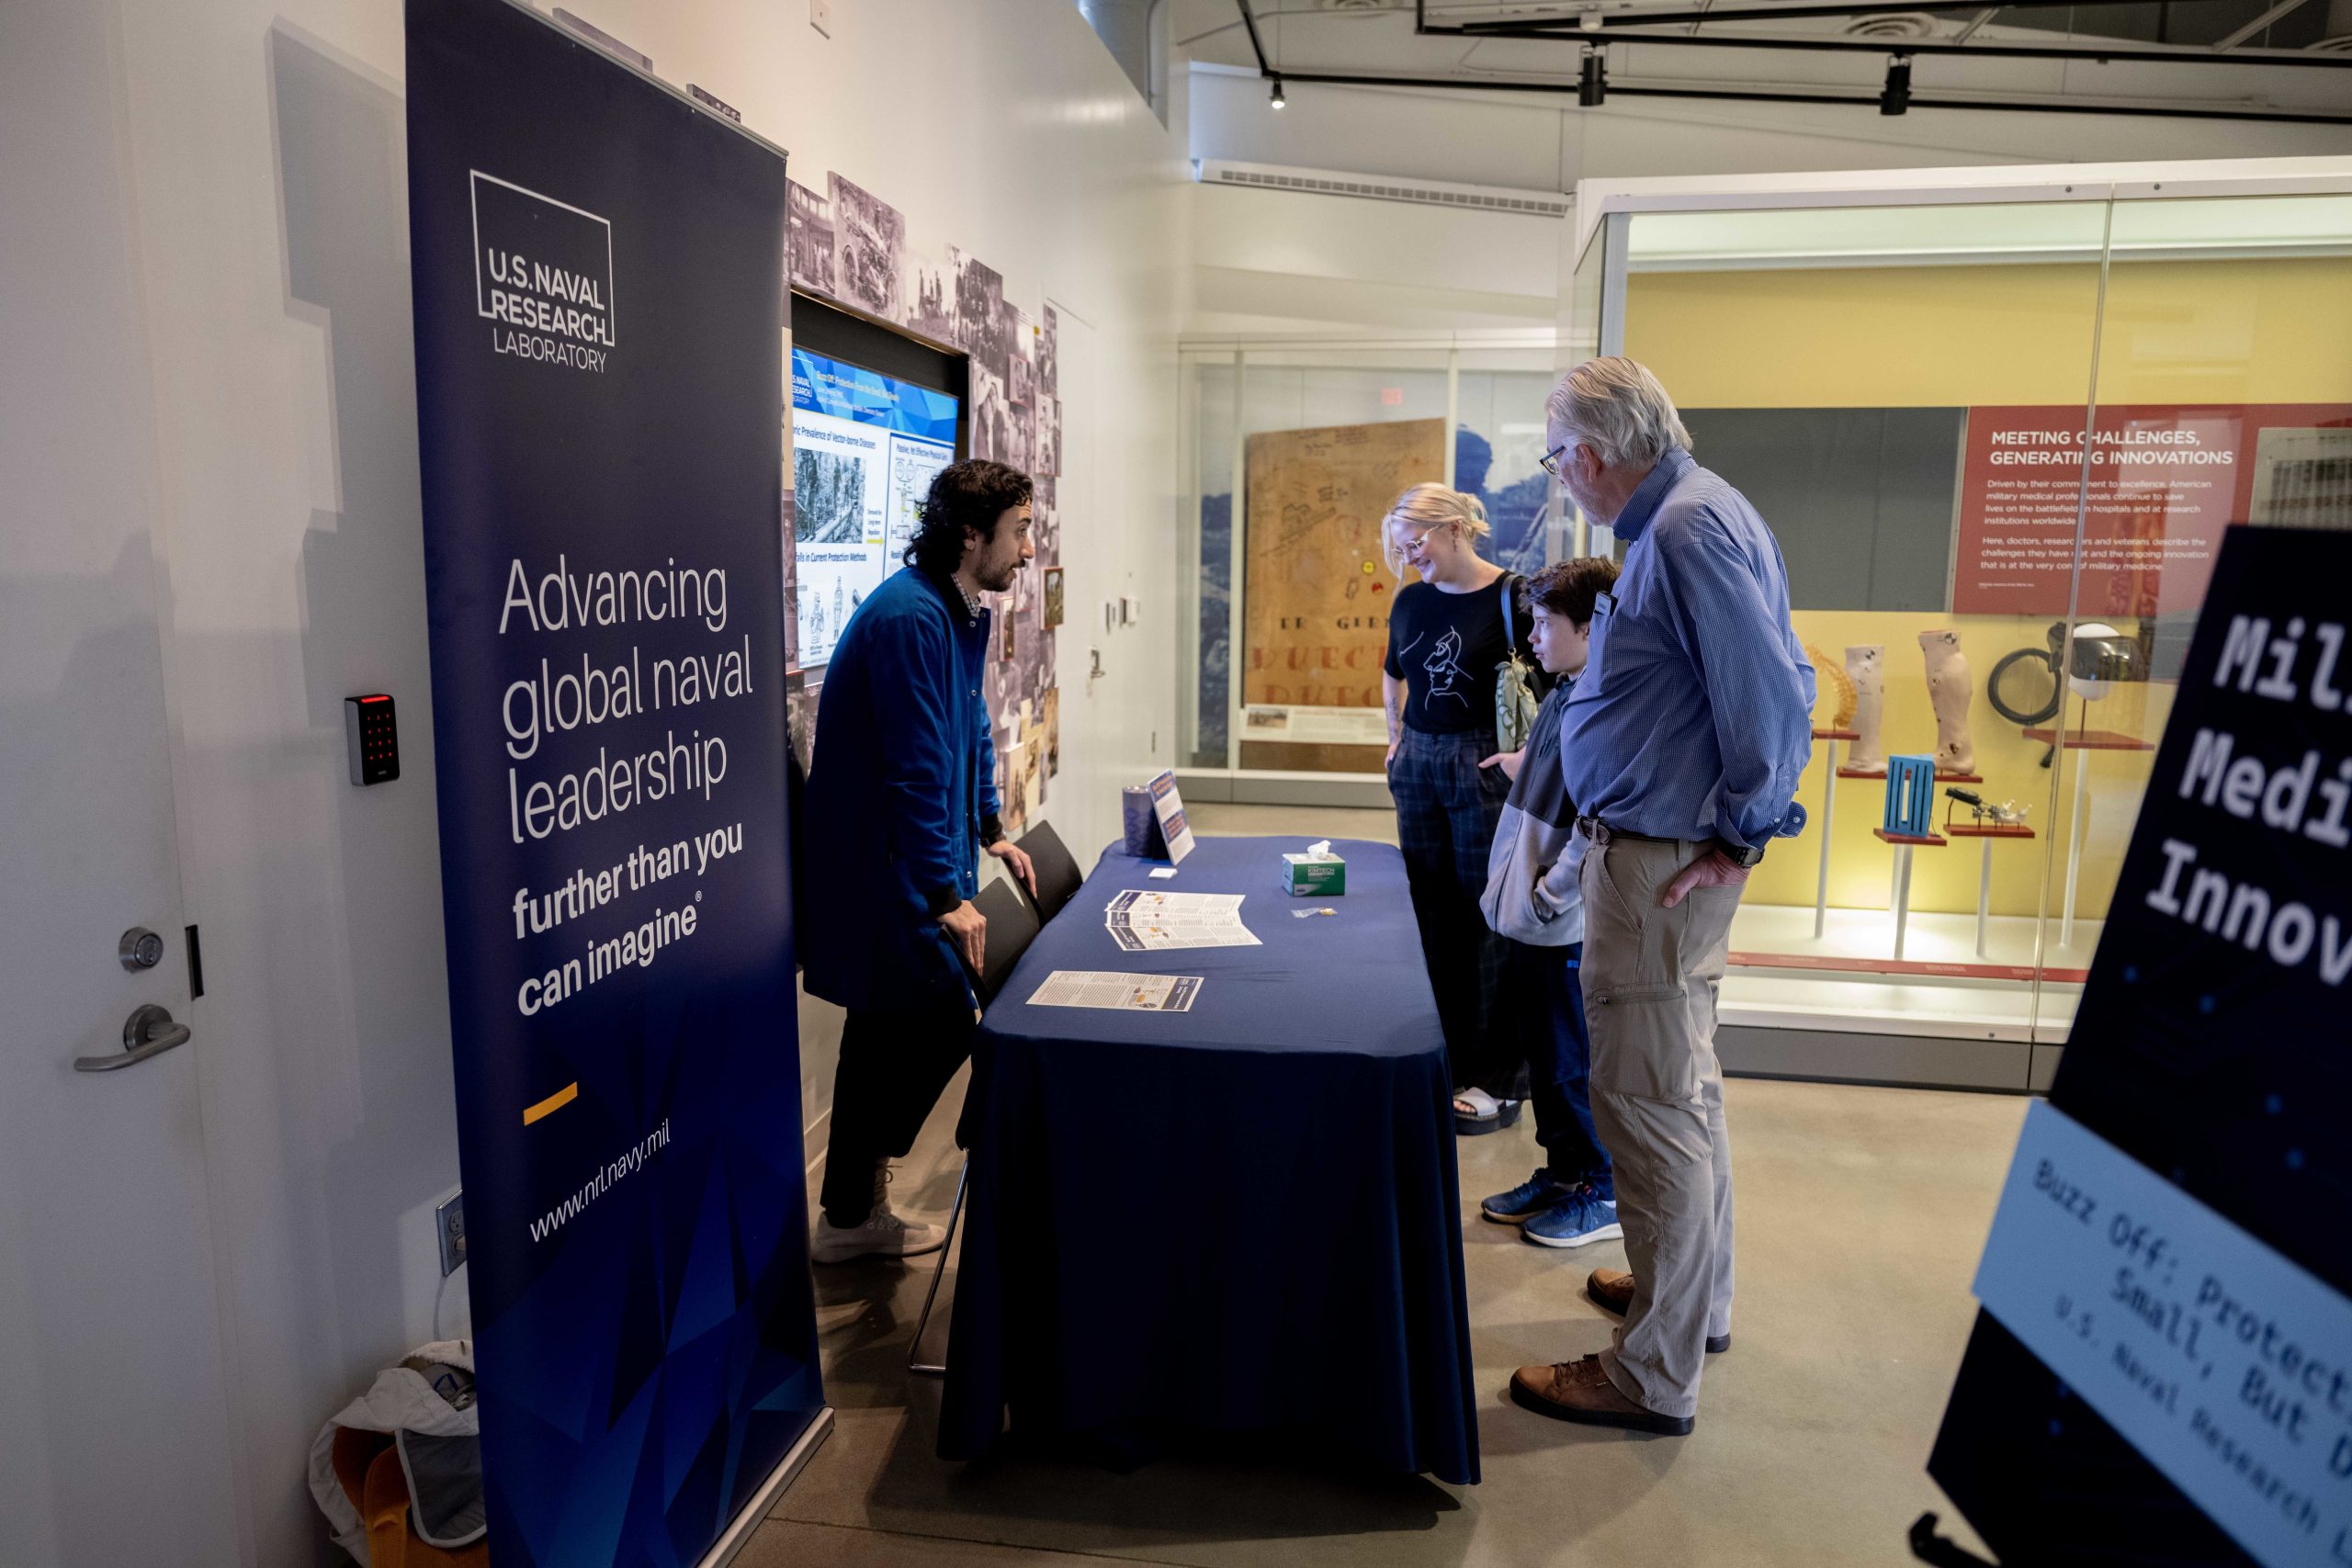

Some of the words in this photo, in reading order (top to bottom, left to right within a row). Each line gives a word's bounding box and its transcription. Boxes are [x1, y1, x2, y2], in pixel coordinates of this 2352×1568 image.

[488, 247, 533, 290] U.S.
[535, 262, 605, 310] NAVAL
[491, 288, 606, 344] RESEARCH
[493, 327, 606, 373] LABORATORY
[802, 426, 826, 440] Prevalence
[827, 431, 832, 441] of
[832, 434, 859, 446] Vector-borne
[1991, 431, 2071, 445] MEETING
[2109, 451, 2233, 465] INNOVATIONS
[1986, 492, 2018, 502] military
[2019, 492, 2053, 501] medical
[2113, 492, 2151, 501] continue
[1987, 479, 2015, 488] Driven
[2017, 479, 2028, 490] by
[2030, 479, 2050, 488] their
[2093, 504, 2132, 513] hospitals
[2133, 504, 2150, 513] and
[2152, 504, 2161, 513] at
[810, 552, 827, 562] Current
[828, 552, 849, 561] Protection
[850, 552, 867, 561] Methods
[1980, 561, 1997, 570] that
[1999, 561, 2007, 570] is
[2008, 561, 2017, 570] at
[2019, 561, 2034, 570] the
[2035, 563, 2054, 571] very
[2079, 561, 2087, 570] of
[2089, 561, 2121, 571] military
[1981, 549, 2026, 558] challenges
[2028, 549, 2047, 558] they
[2049, 549, 2069, 558] have
[2090, 549, 2108, 558] and
[2125, 550, 2161, 559] ongoing
[2164, 550, 2210, 558] innovation
[2095, 537, 2111, 546] and
[2152, 537, 2189, 546] describe
[2191, 537, 2206, 546] the
[499, 553, 727, 634] Advancing
[2211, 612, 2352, 715] Mil
[503, 646, 644, 761] global
[653, 634, 753, 710] naval
[509, 729, 727, 844] leadership
[2177, 727, 2352, 849] Medi
[513, 863, 623, 940] further
[628, 840, 689, 891] than
[695, 822, 743, 876] you
[2144, 837, 2352, 987] Innov
[518, 958, 582, 1016] can
[529, 1118, 671, 1243] www.nrl.navy.mil
[2033, 1157, 2098, 1226] Buzz
[2108, 1212, 2179, 1286] Off:
[2196, 1273, 2352, 1426] Protect
[2109, 1265, 2213, 1381] Small,
[2239, 1366, 2309, 1446] But
[2053, 1293, 2100, 1348] U.S.
[2112, 1341, 2179, 1417] Naval
[2188, 1405, 2318, 1535] Research
